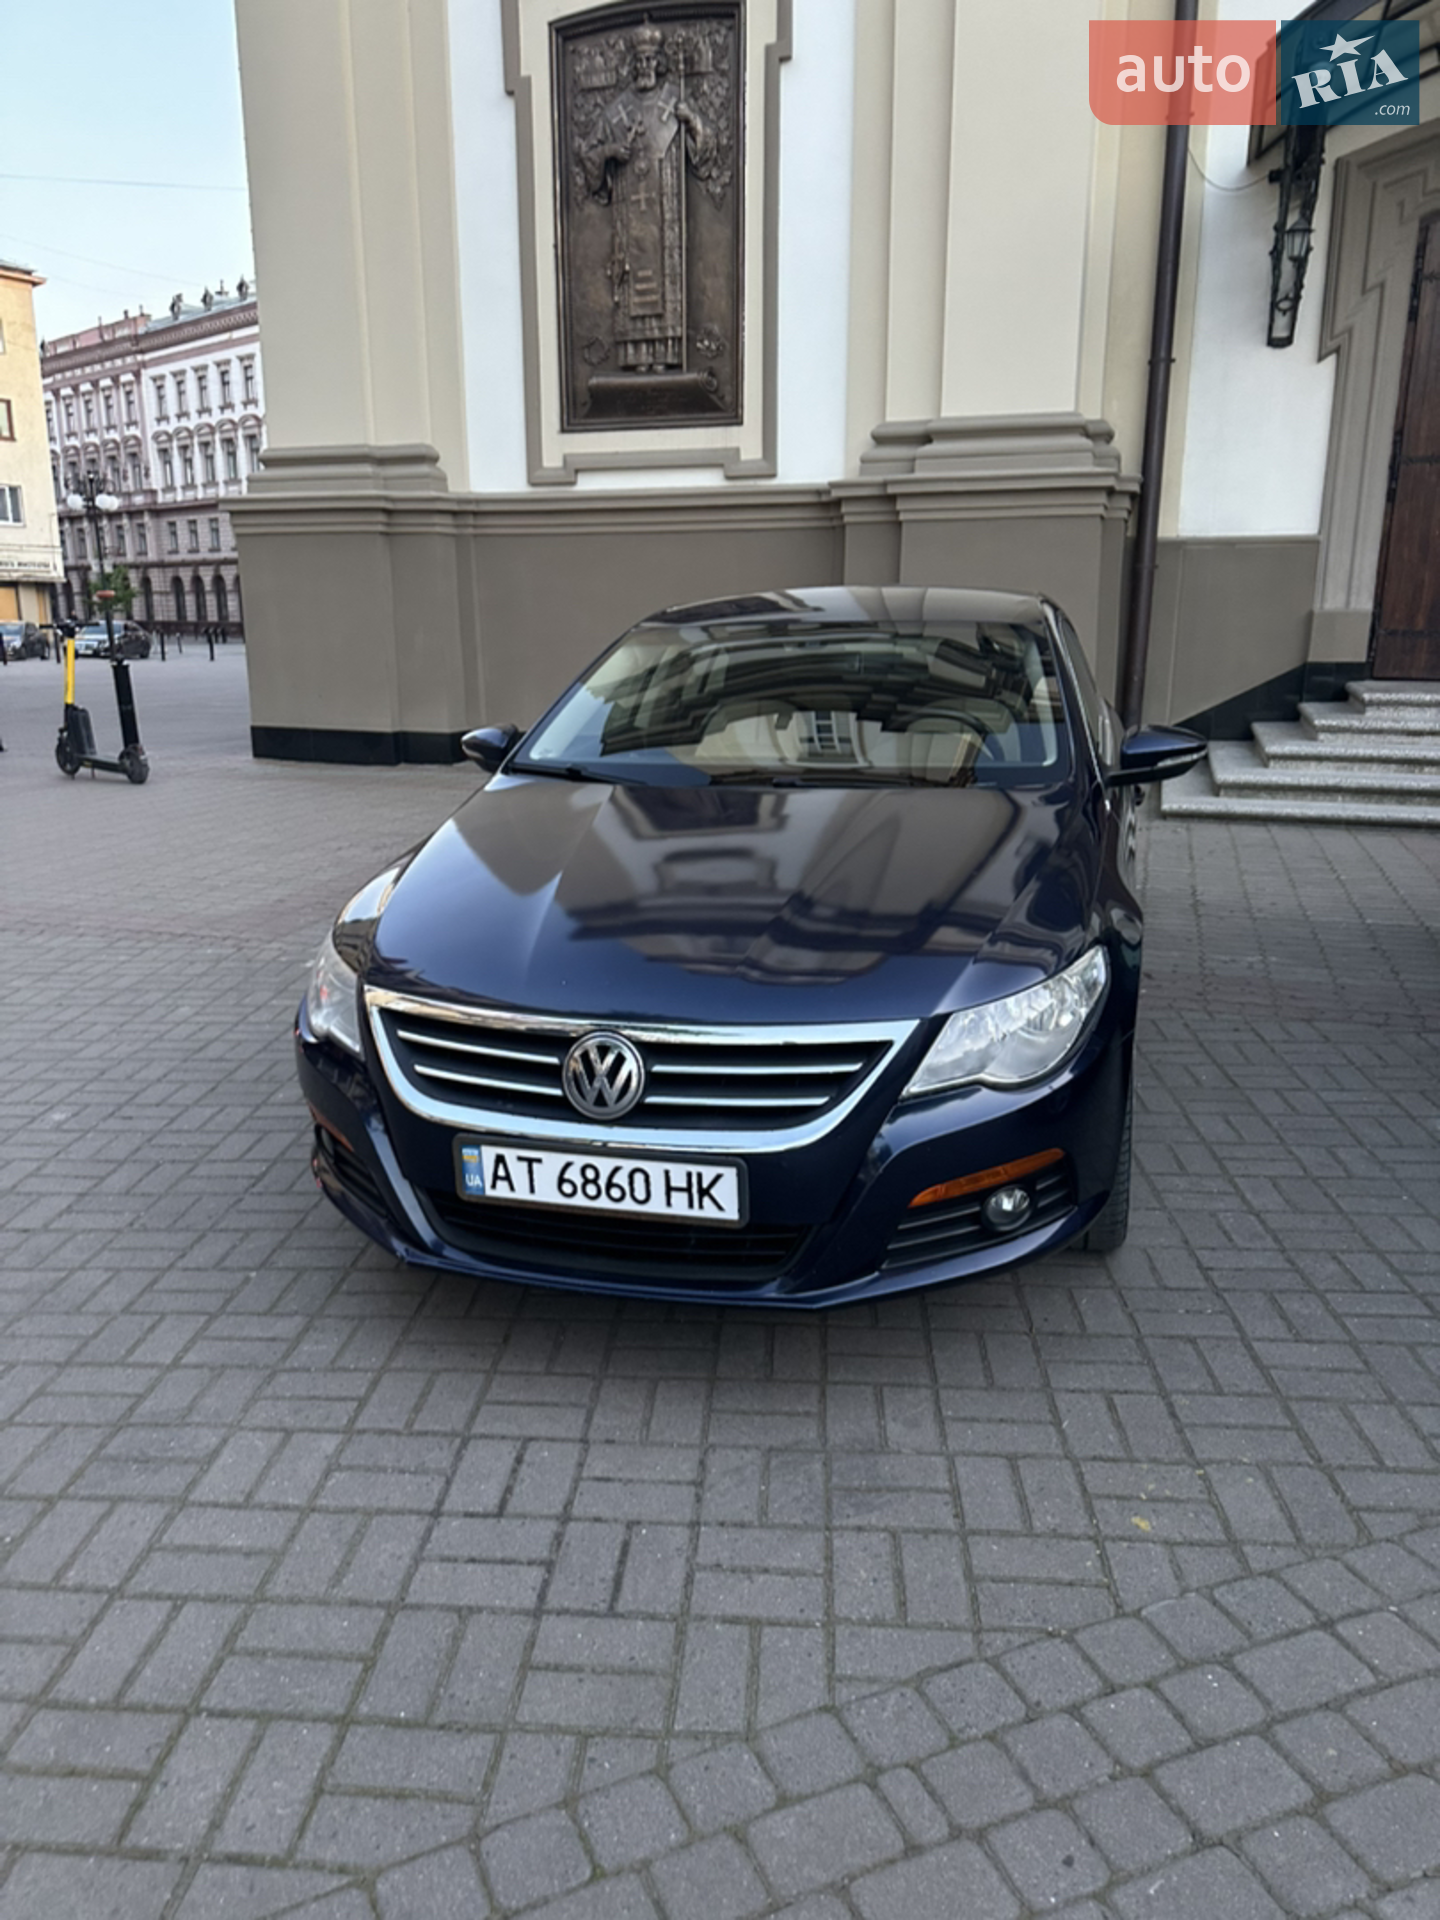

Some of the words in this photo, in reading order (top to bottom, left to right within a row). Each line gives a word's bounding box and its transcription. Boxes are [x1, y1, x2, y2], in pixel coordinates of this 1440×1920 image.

[566, 1039, 639, 1112] VW
[465, 1172, 484, 1188] UA
[490, 1153, 543, 1194] AT
[557, 1161, 651, 1205] 6860
[664, 1169, 726, 1212] HK
